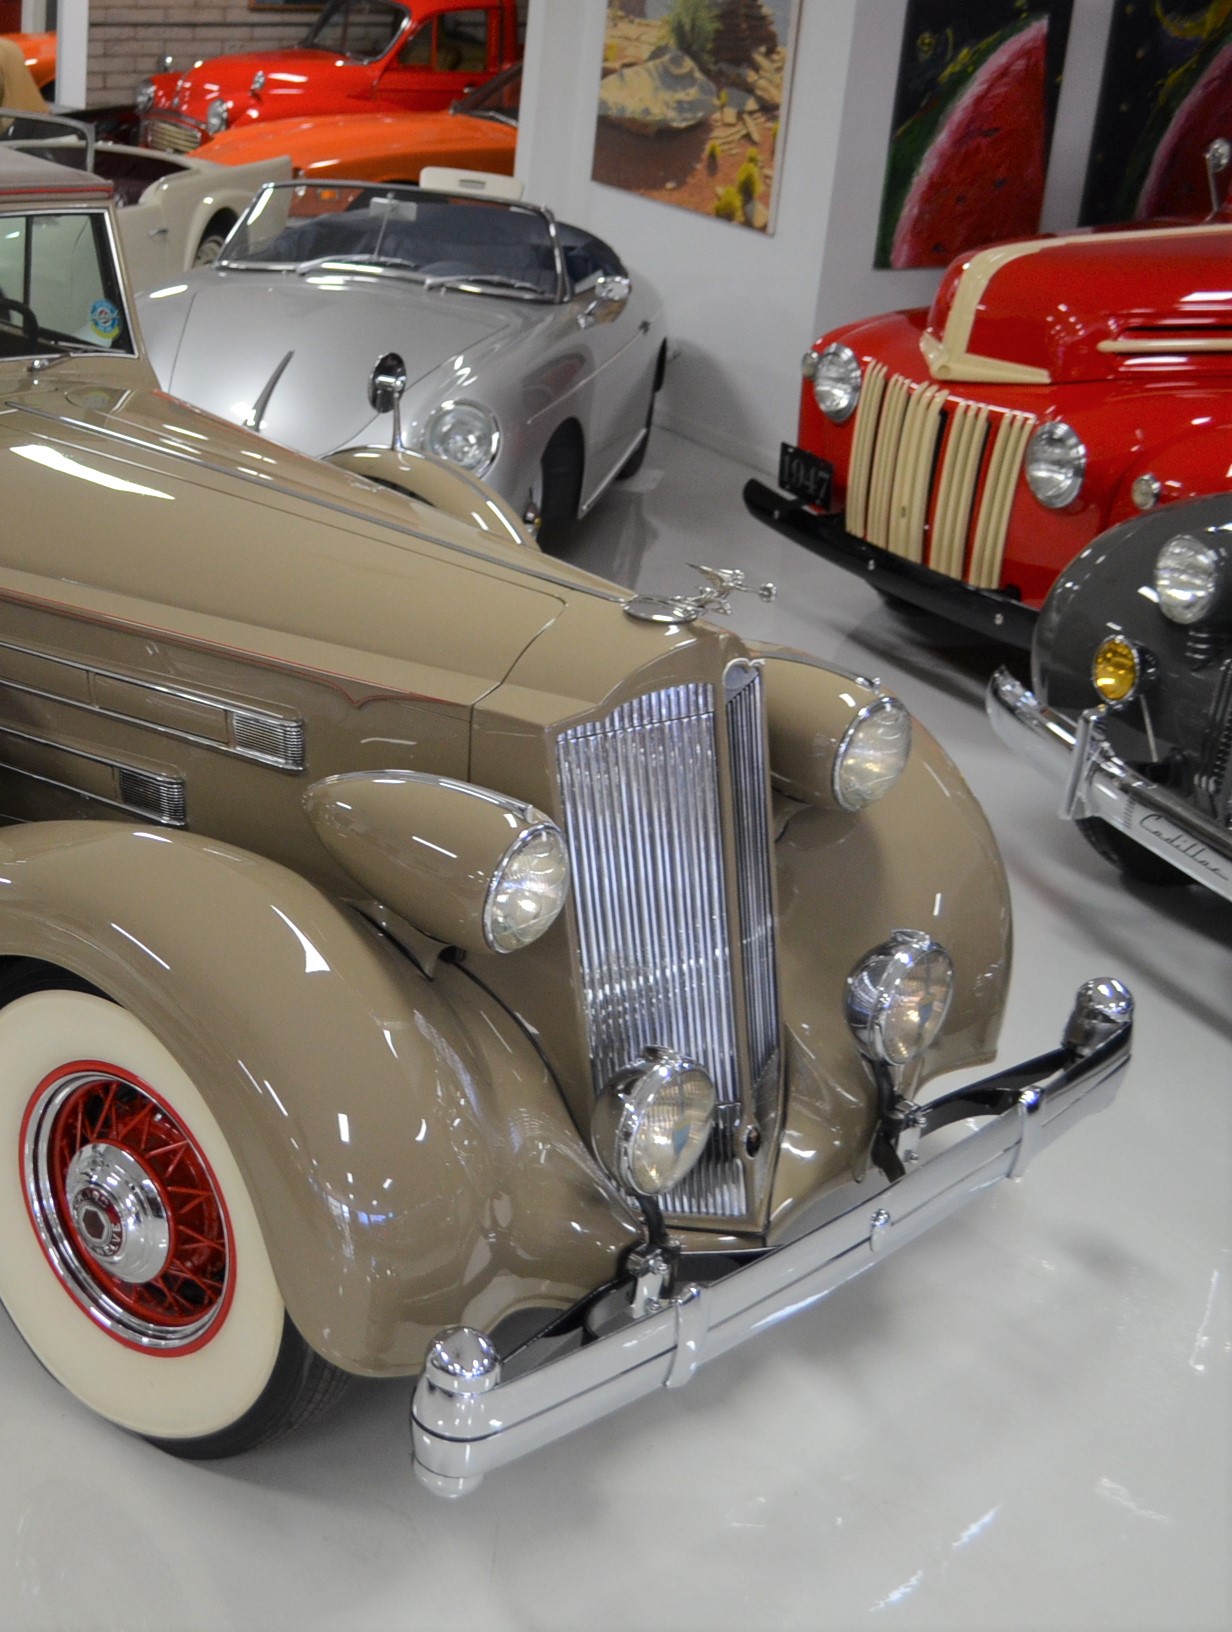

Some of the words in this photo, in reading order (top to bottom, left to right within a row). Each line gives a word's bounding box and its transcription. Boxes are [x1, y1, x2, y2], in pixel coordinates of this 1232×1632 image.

[782, 454, 830, 499] 1947
[1140, 813, 1229, 881] Cadillac
[87, 1223, 121, 1257] WELVE
